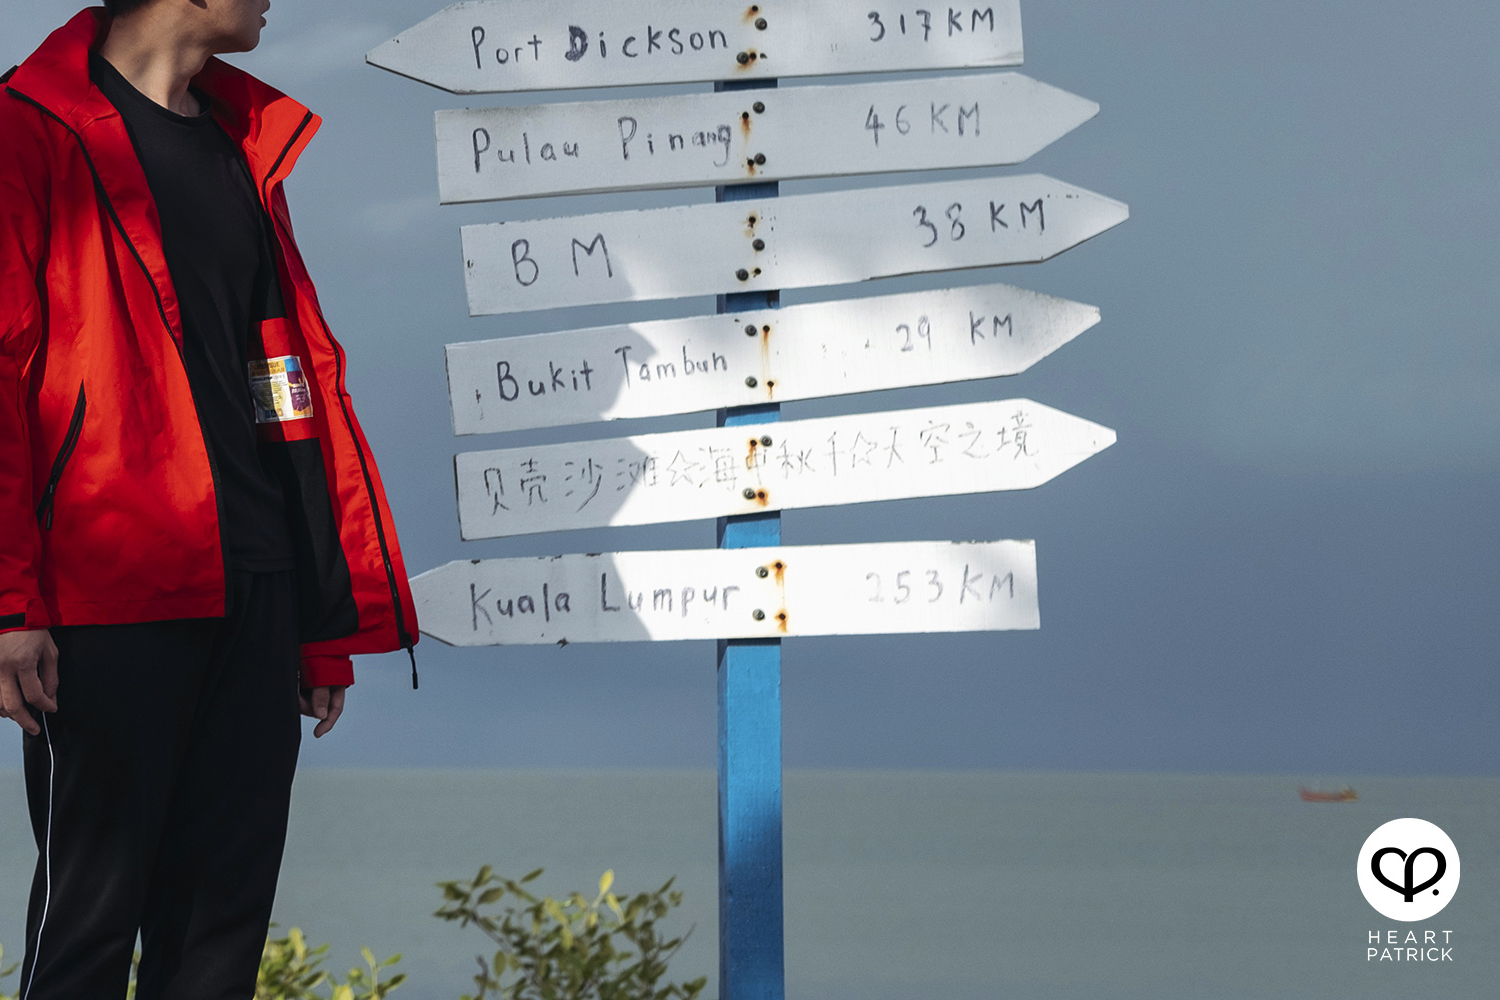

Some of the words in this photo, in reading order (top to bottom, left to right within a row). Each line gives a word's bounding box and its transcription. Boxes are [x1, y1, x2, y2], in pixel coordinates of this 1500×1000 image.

[470, 25, 543, 70] Port
[563, 24, 729, 62] Dickson
[471, 127, 580, 174] Pulau
[616, 115, 733, 168] Pinang
[912, 201, 966, 249] 38
[988, 197, 1046, 233] KM
[496, 358, 595, 403] Bukit
[615, 345, 729, 391] Tambun
[895, 314, 933, 352] 29
[968, 310, 1014, 346] KM
[469, 582, 571, 631] Kuala
[601, 572, 741, 618] Lumpur
